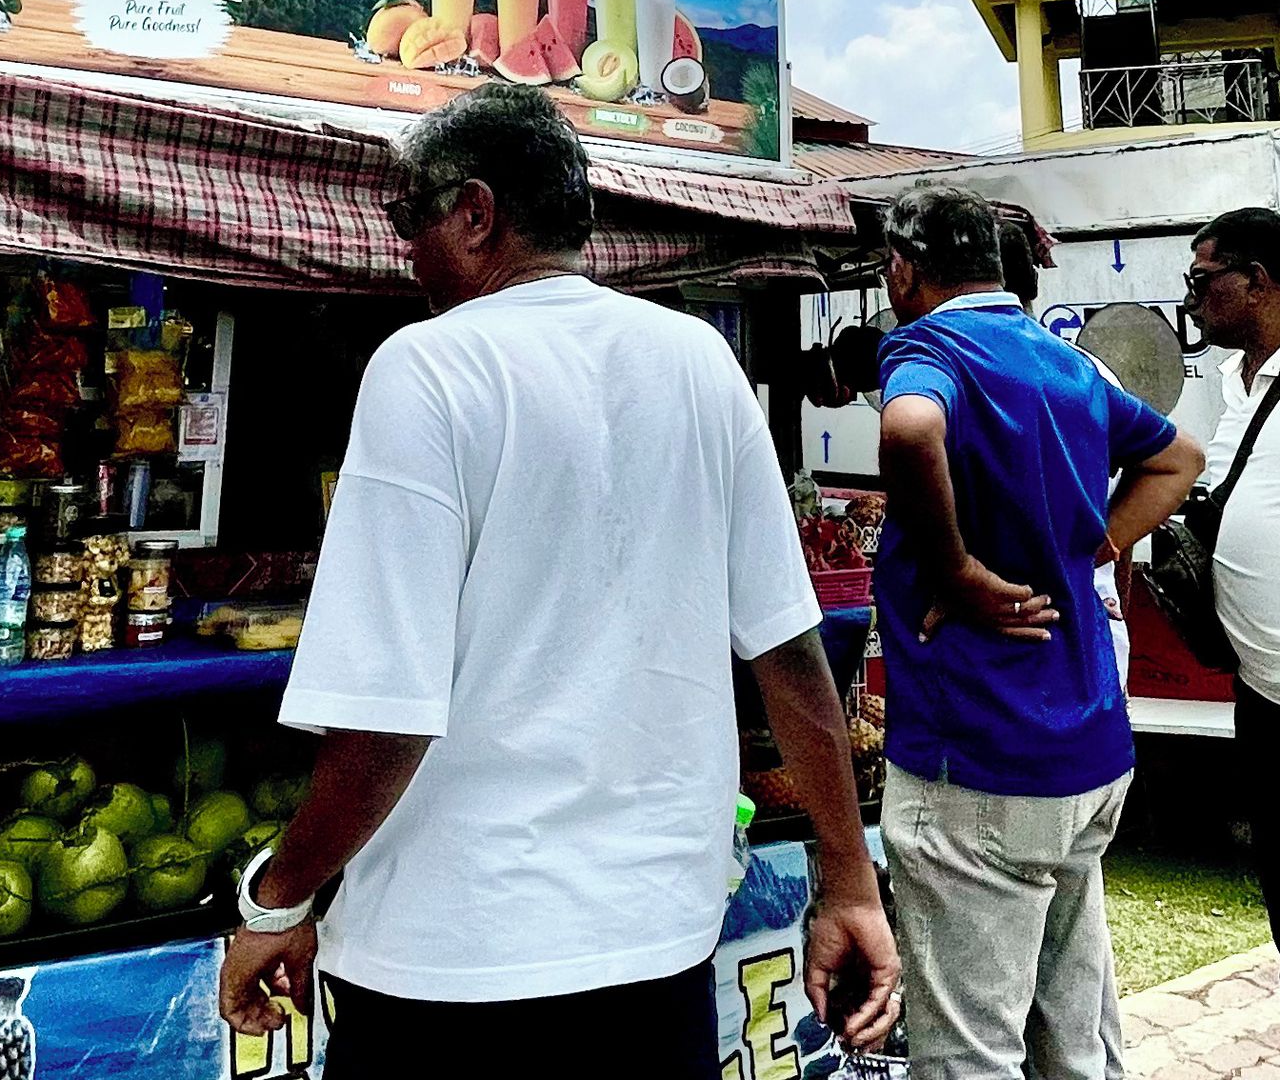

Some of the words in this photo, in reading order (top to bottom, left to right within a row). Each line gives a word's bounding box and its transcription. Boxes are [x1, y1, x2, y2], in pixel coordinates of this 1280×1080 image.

[125, 0, 153, 16] Pure
[157, 0, 187, 16] Fruit
[109, 15, 138, 31] Pure
[141, 17, 202, 33] Goodness!
[388, 81, 422, 96] MANGO
[674, 122, 708, 134] COCONUT
